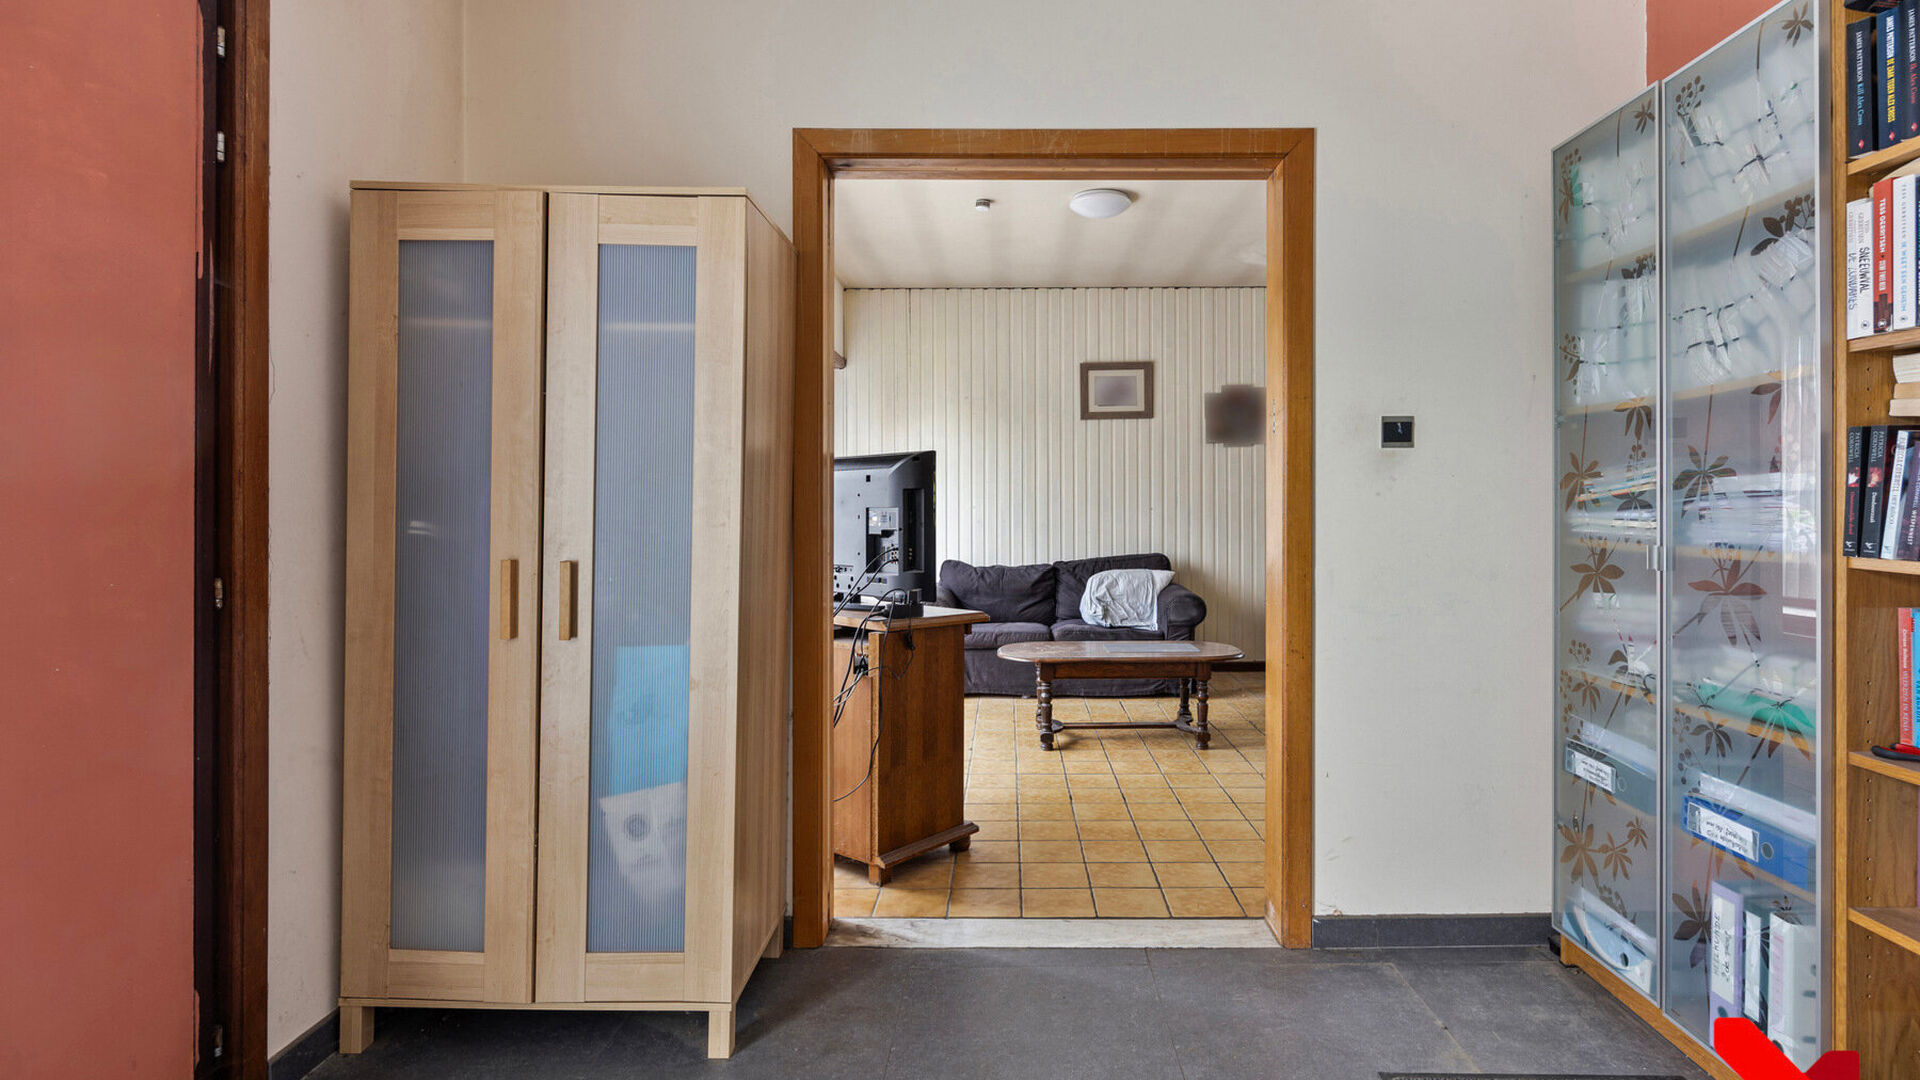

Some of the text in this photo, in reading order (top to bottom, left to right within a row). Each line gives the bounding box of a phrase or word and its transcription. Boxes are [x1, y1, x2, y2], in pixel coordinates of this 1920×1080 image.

[1886, 15, 1895, 32] JAMES
[1908, 9, 1916, 28] JAMES
[1886, 31, 1895, 59] PATTERSON
[1909, 28, 1917, 62] PATTERSON
[1856, 50, 1864, 82] PATTERSON
[1856, 83, 1864, 95] Kill
[1887, 106, 1896, 123] CROSS
[1859, 247, 1871, 293] SNEEUWVAL
[1871, 430, 1879, 463] CORNWELL
[1877, 431, 1885, 458] PATRICIA
